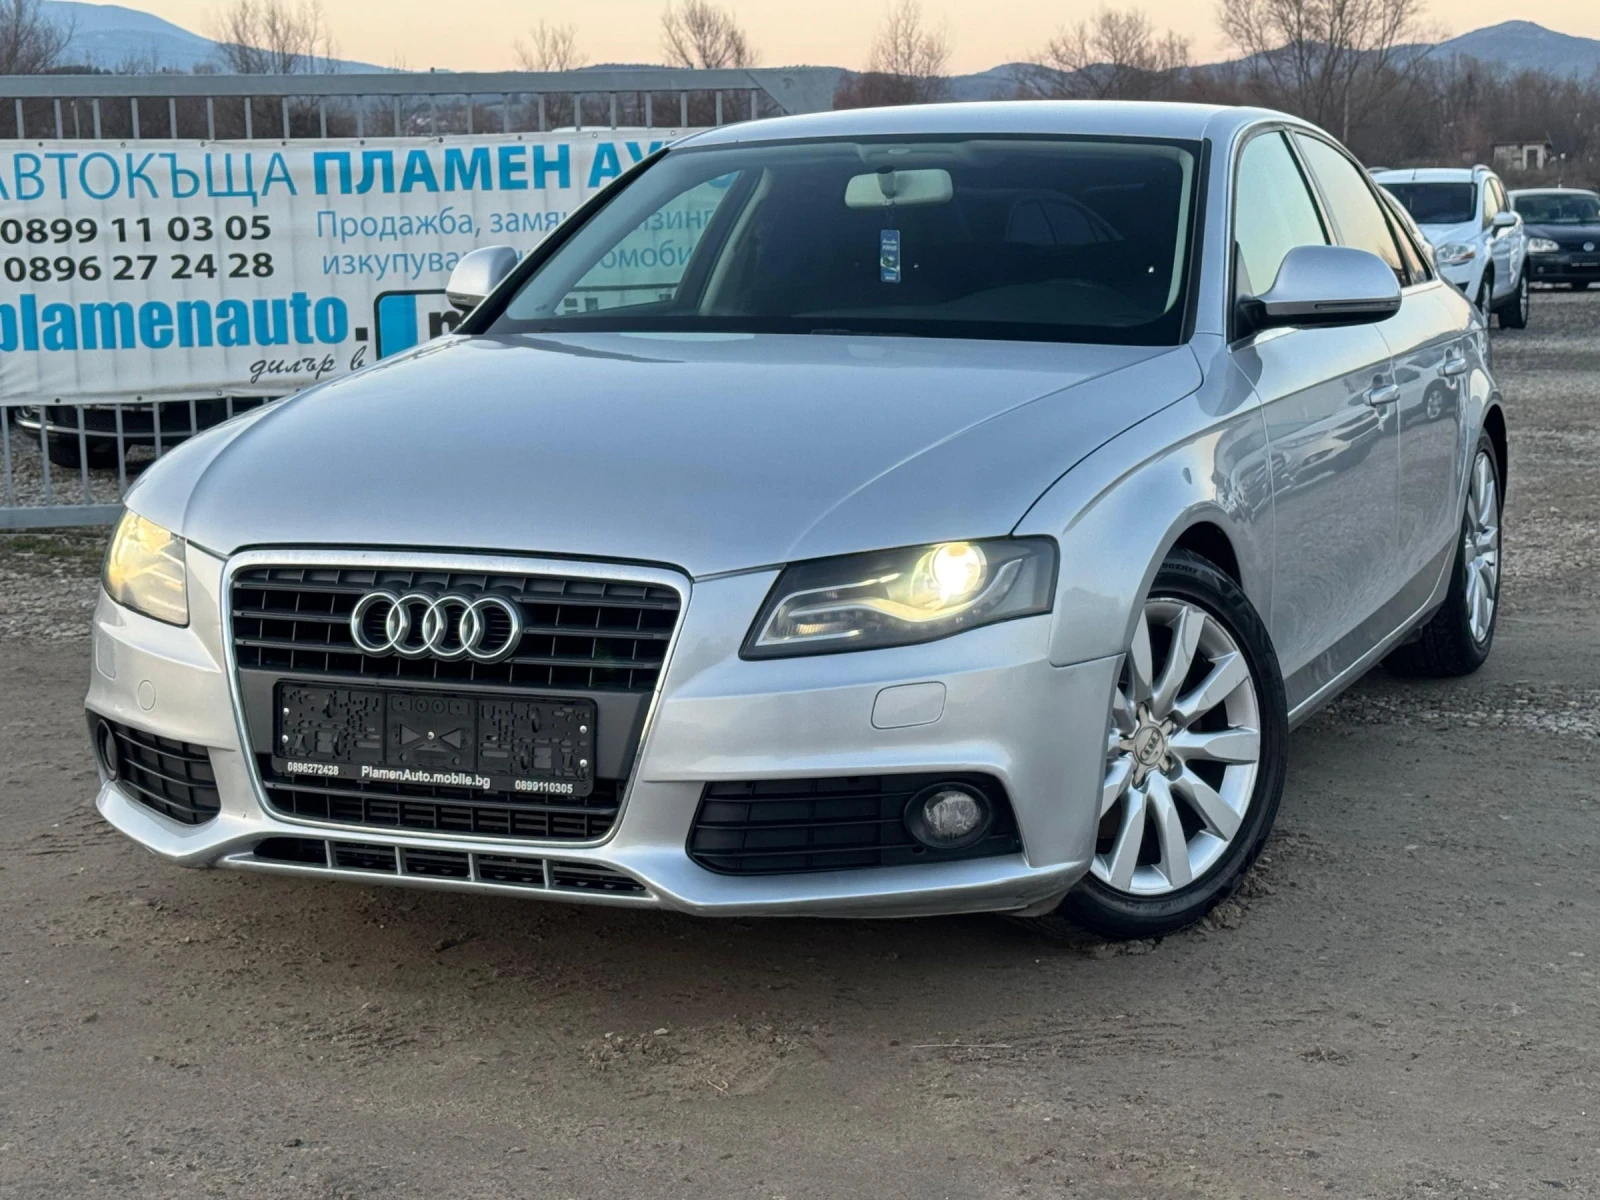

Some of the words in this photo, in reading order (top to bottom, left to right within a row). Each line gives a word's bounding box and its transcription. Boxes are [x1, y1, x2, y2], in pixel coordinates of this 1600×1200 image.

[313, 144, 571, 195] ПЛАМЕН
[0, 218, 98, 244] 0899
[111, 217, 151, 243] 11
[167, 216, 214, 242] 03
[225, 215, 271, 240] 05
[317, 206, 481, 244] Продажба,
[490, 210, 567, 233] замя
[4, 255, 102, 282] 0896
[112, 254, 158, 281] 27
[171, 253, 217, 279] 24
[228, 252, 274, 278] 28
[323, 250, 468, 281] изкупува
[287, 761, 340, 776] 0896272428
[361, 765, 491, 789] PlamenAuto.mobile.bg
[515, 779, 574, 794] 0899110305
